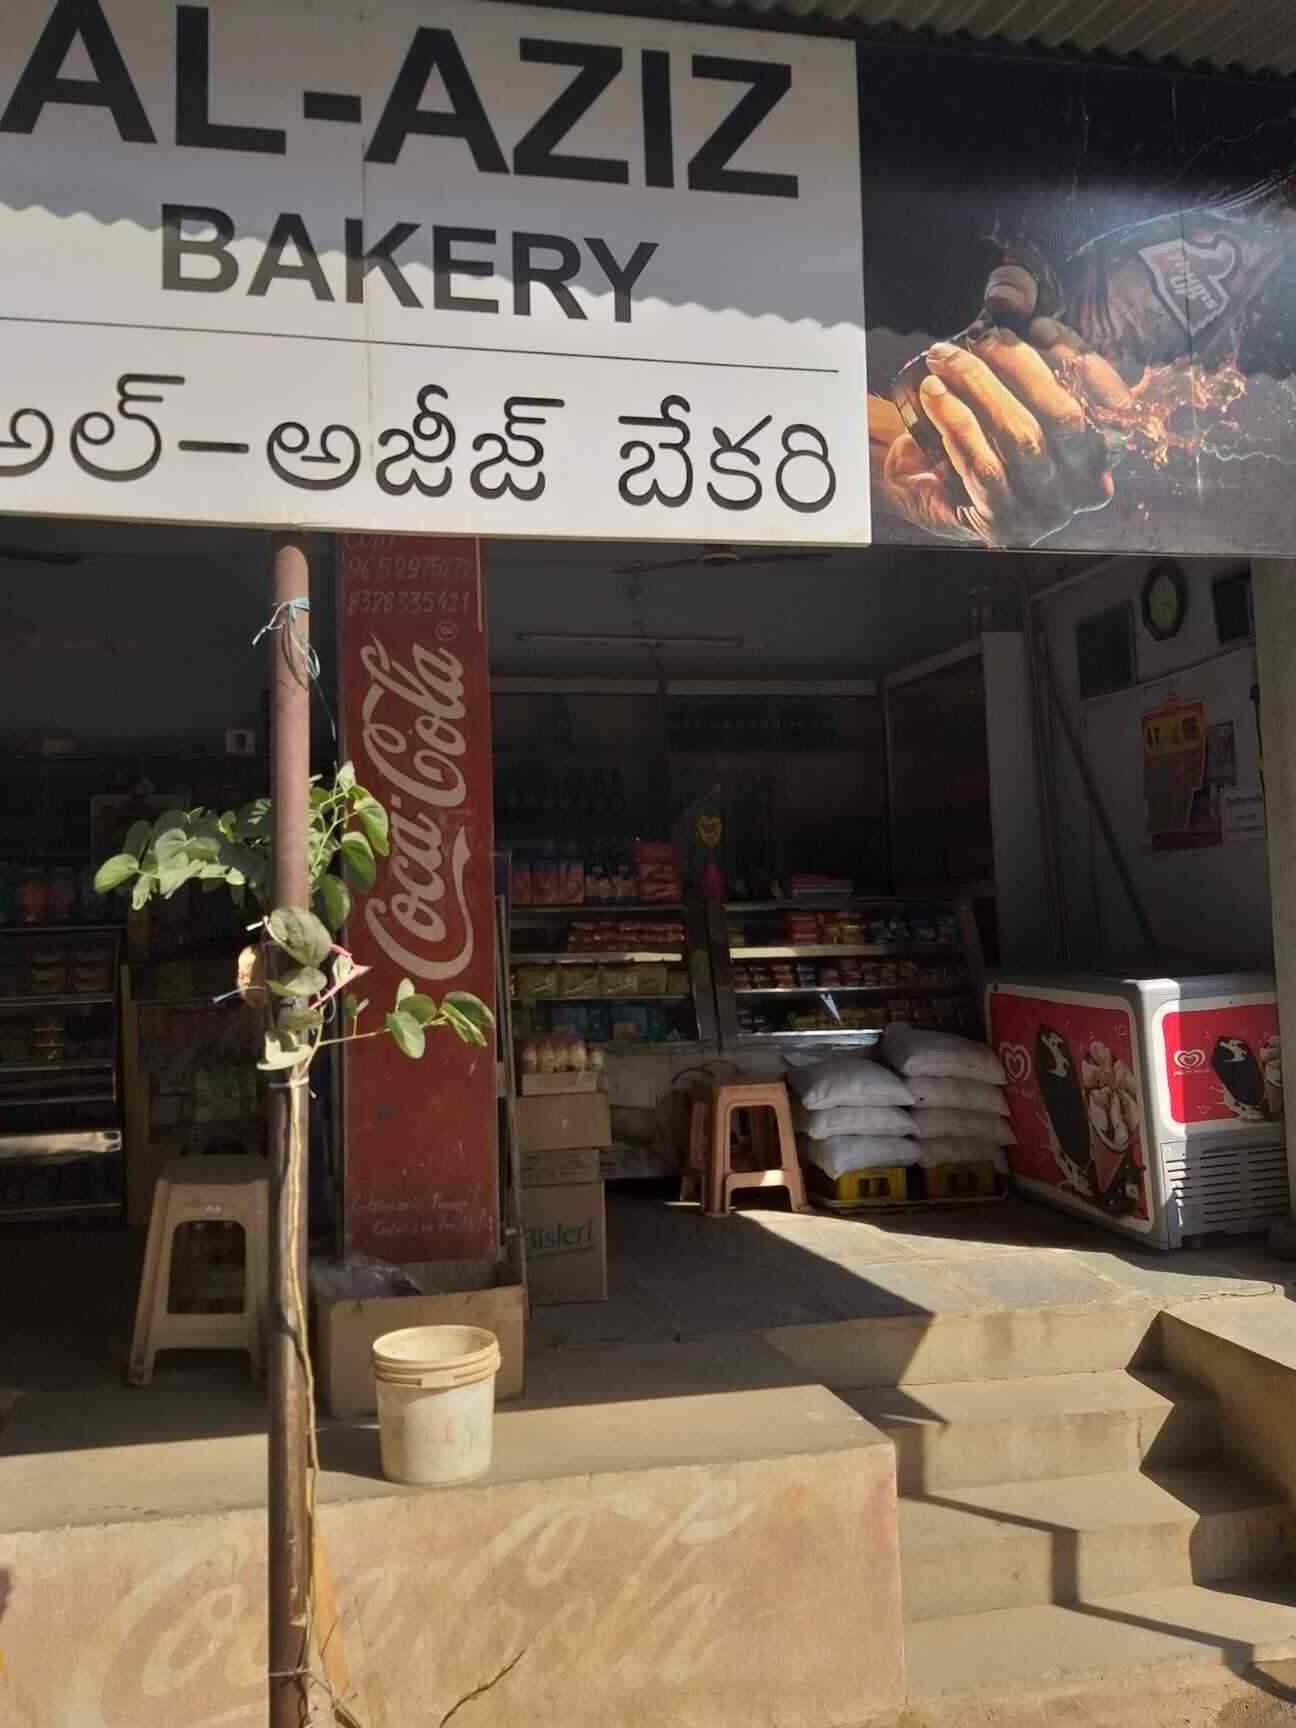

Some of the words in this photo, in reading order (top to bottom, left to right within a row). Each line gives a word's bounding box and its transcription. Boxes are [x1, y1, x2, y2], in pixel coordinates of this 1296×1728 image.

[0, 0, 799, 199] AL-AZIZ
[161, 203, 659, 323] BAKERY
[618, 394, 837, 513] బేకరి
